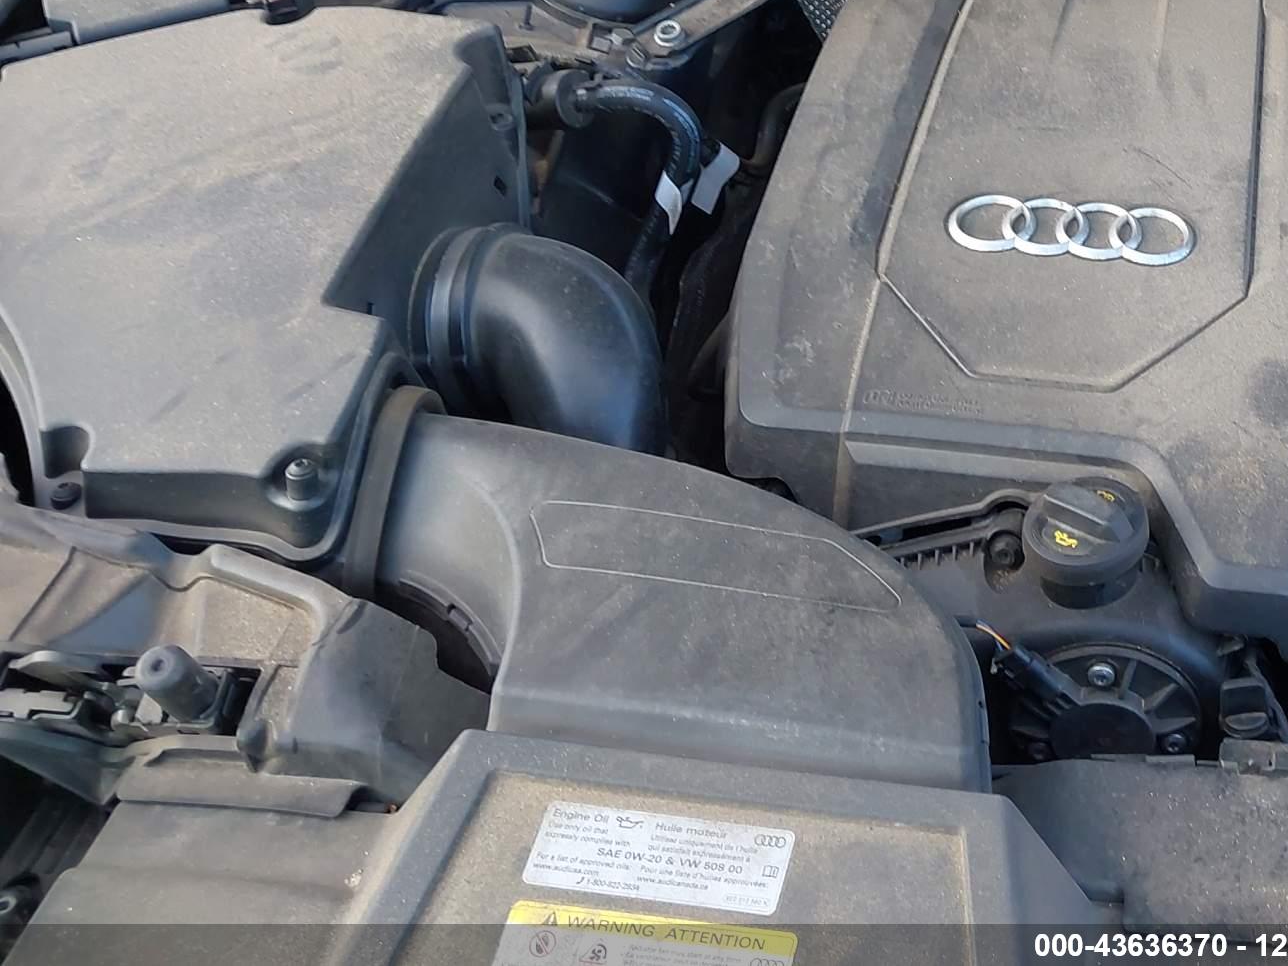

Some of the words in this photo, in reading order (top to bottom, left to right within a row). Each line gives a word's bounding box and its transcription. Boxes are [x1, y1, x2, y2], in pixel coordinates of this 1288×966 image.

[552, 808, 590, 822] Engine
[594, 814, 609, 824] Oil
[582, 825, 592, 833] oil
[655, 822, 683, 833] Huile
[686, 827, 728, 839] moteur
[615, 839, 631, 847] with
[536, 850, 549, 859] For
[570, 855, 579, 864] of
[580, 858, 615, 869] approved
[597, 847, 622, 859] SAE
[624, 851, 662, 863] 0W-20
[665, 856, 674, 865] &
[680, 857, 701, 869] VW
[728, 864, 743, 874] 00
[640, 864, 657, 875] Pour
[568, 915, 656, 937] WARNING
[664, 927, 766, 950] ATTENTION
